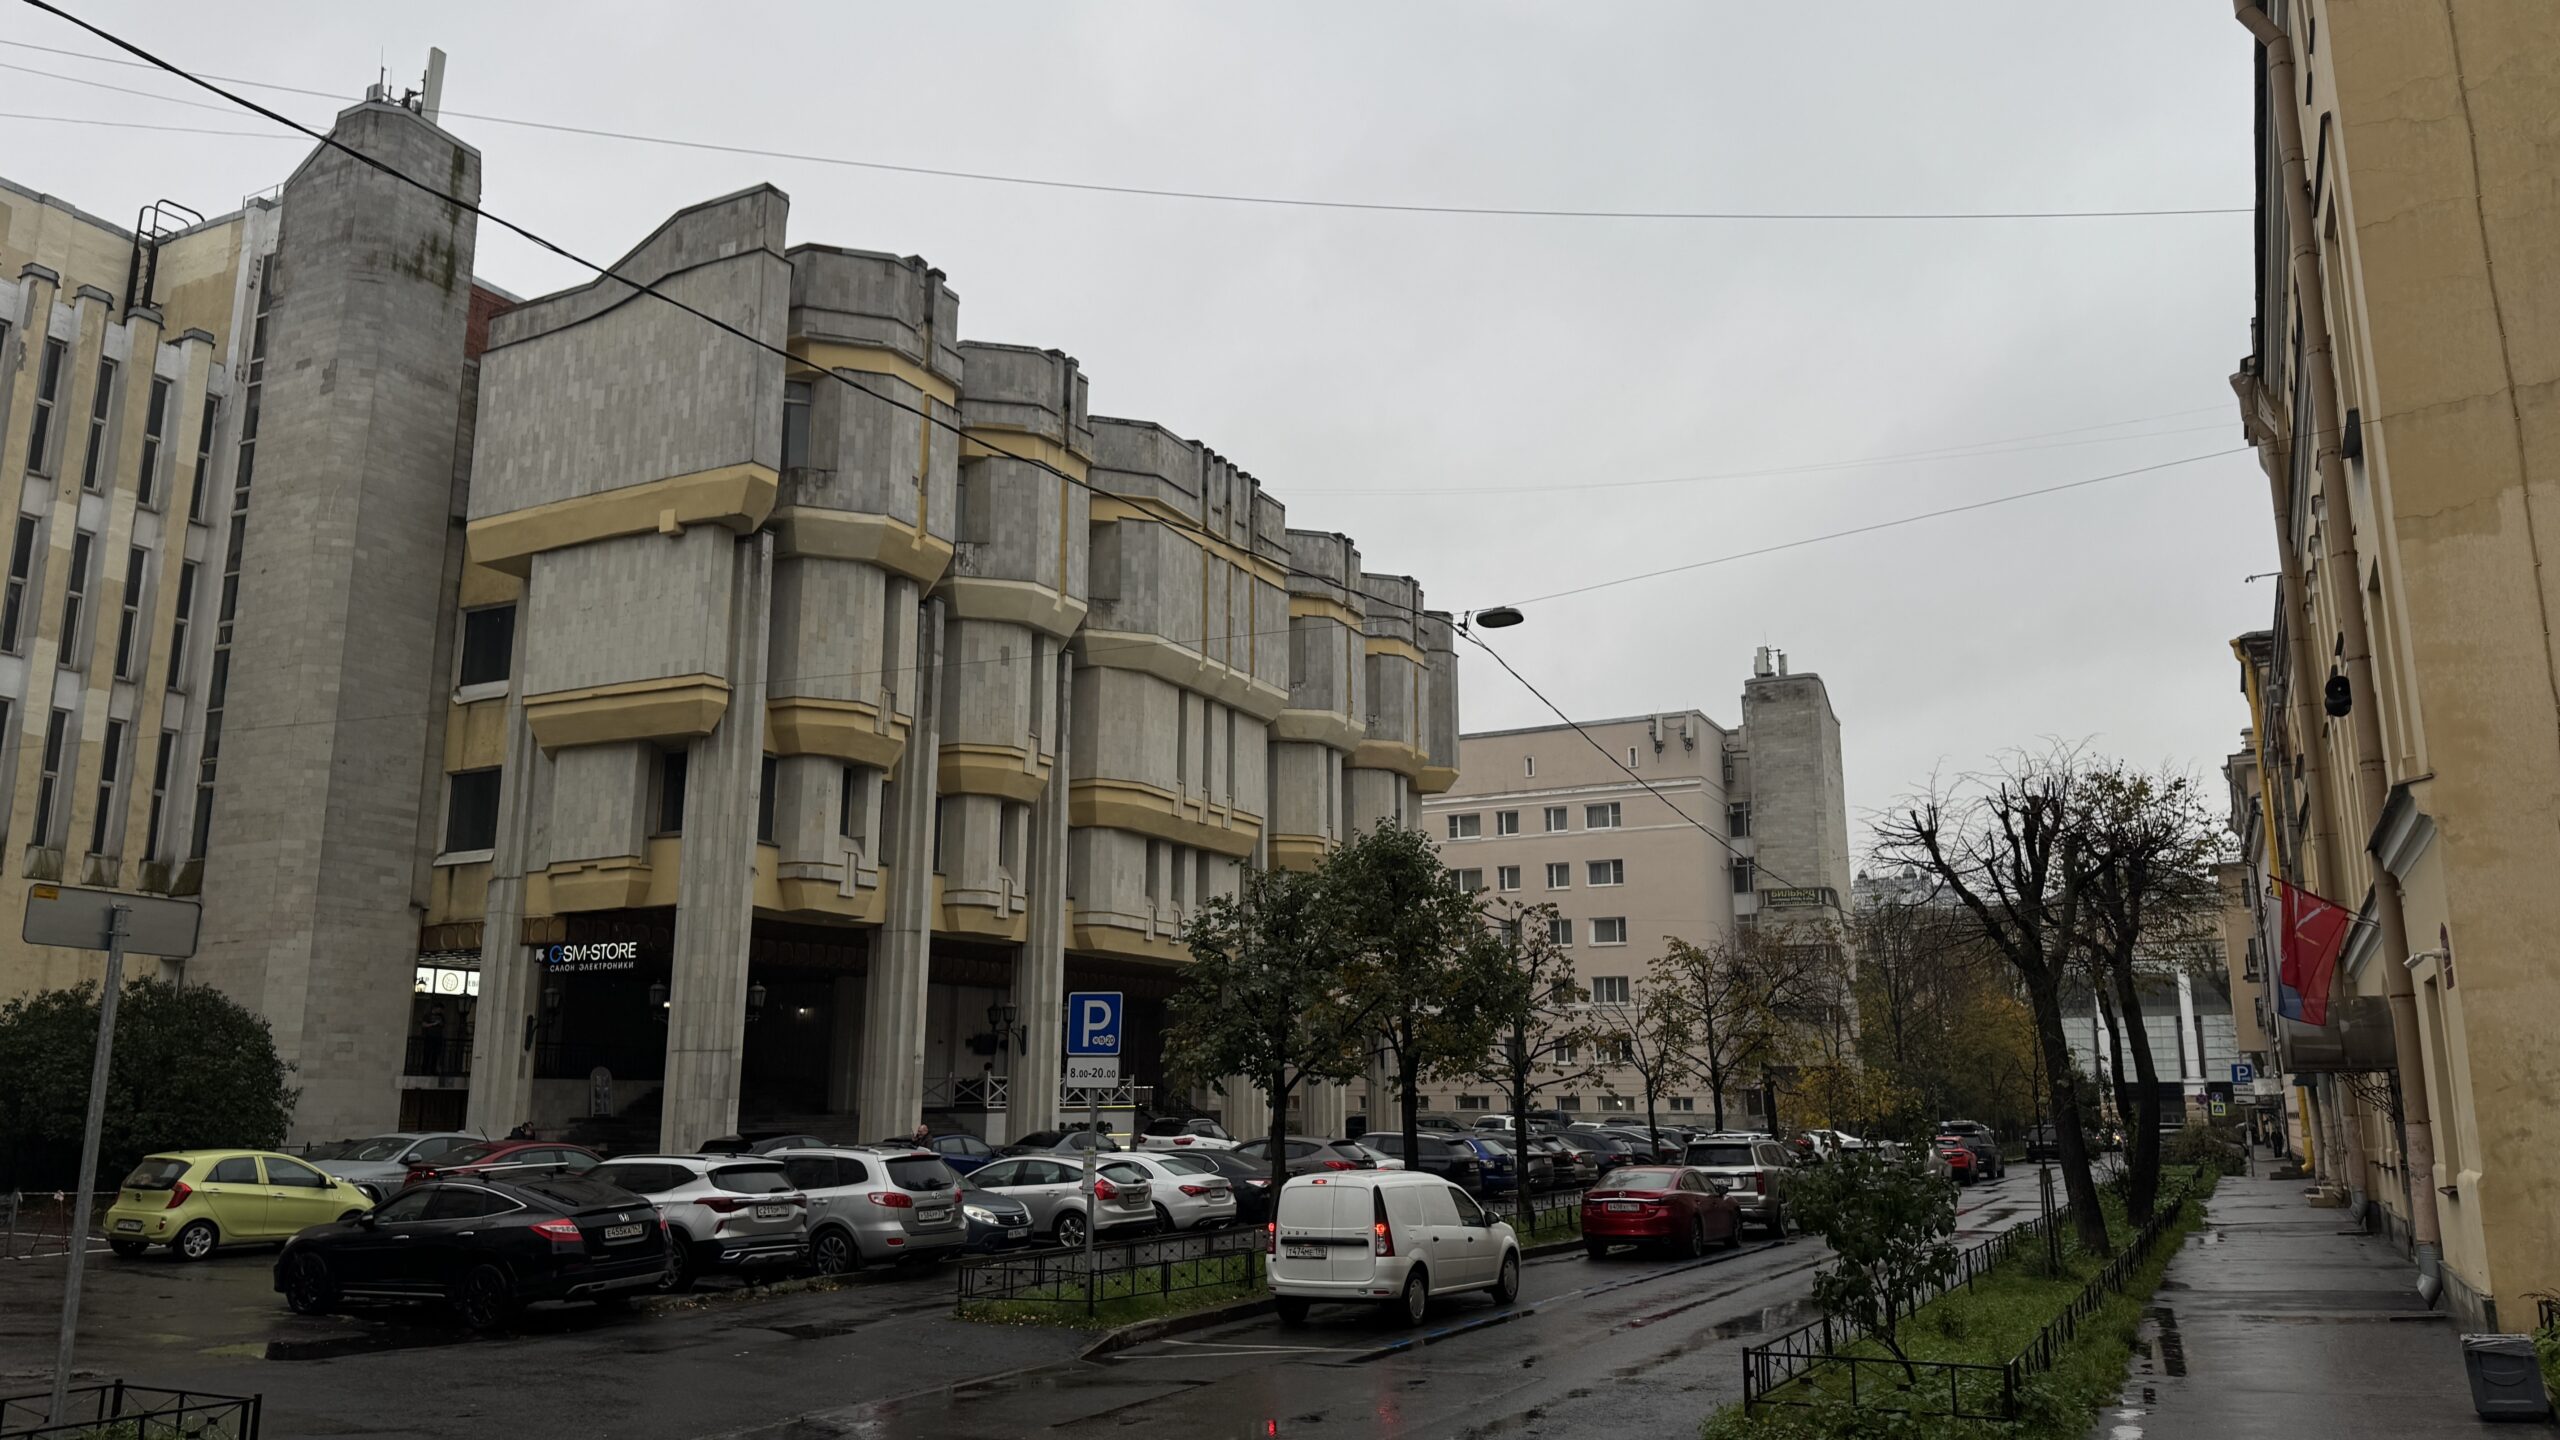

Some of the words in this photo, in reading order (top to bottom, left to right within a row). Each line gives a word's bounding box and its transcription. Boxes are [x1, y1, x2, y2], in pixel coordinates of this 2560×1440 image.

[549, 964, 575, 973] САЛОН
[578, 961, 634, 971] ЭЛЕКТРОНИКИ
[1082, 1000, 1112, 1047] P
[1106, 1036, 1114, 1044] 20
[1070, 1067, 1116, 1078] 8.00-20.00
[2236, 1066, 2249, 1081] P
